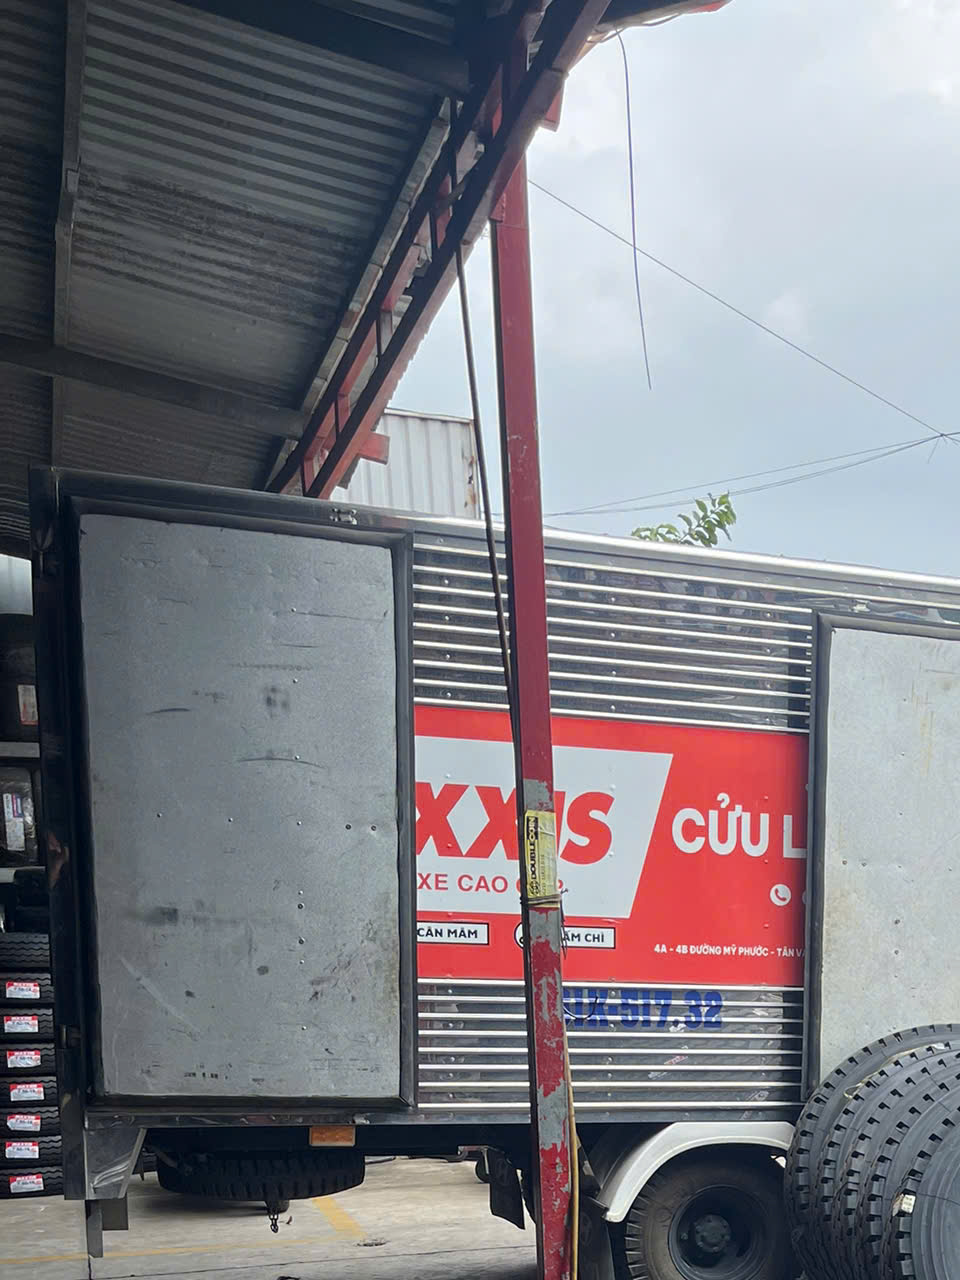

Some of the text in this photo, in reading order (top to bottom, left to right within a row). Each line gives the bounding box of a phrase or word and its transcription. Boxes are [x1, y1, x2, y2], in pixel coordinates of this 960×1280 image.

[672, 793, 807, 859] CỬU L
[417, 872, 448, 890] XE
[458, 874, 508, 893] CAO
[654, 944, 667, 954] 4A
[675, 944, 688, 954] 4B
[689, 942, 722, 955] ĐƯỜNG
[723, 944, 737, 956] MỸ
[738, 945, 769, 957] PHƯỚC
[776, 945, 794, 957] TÂN
